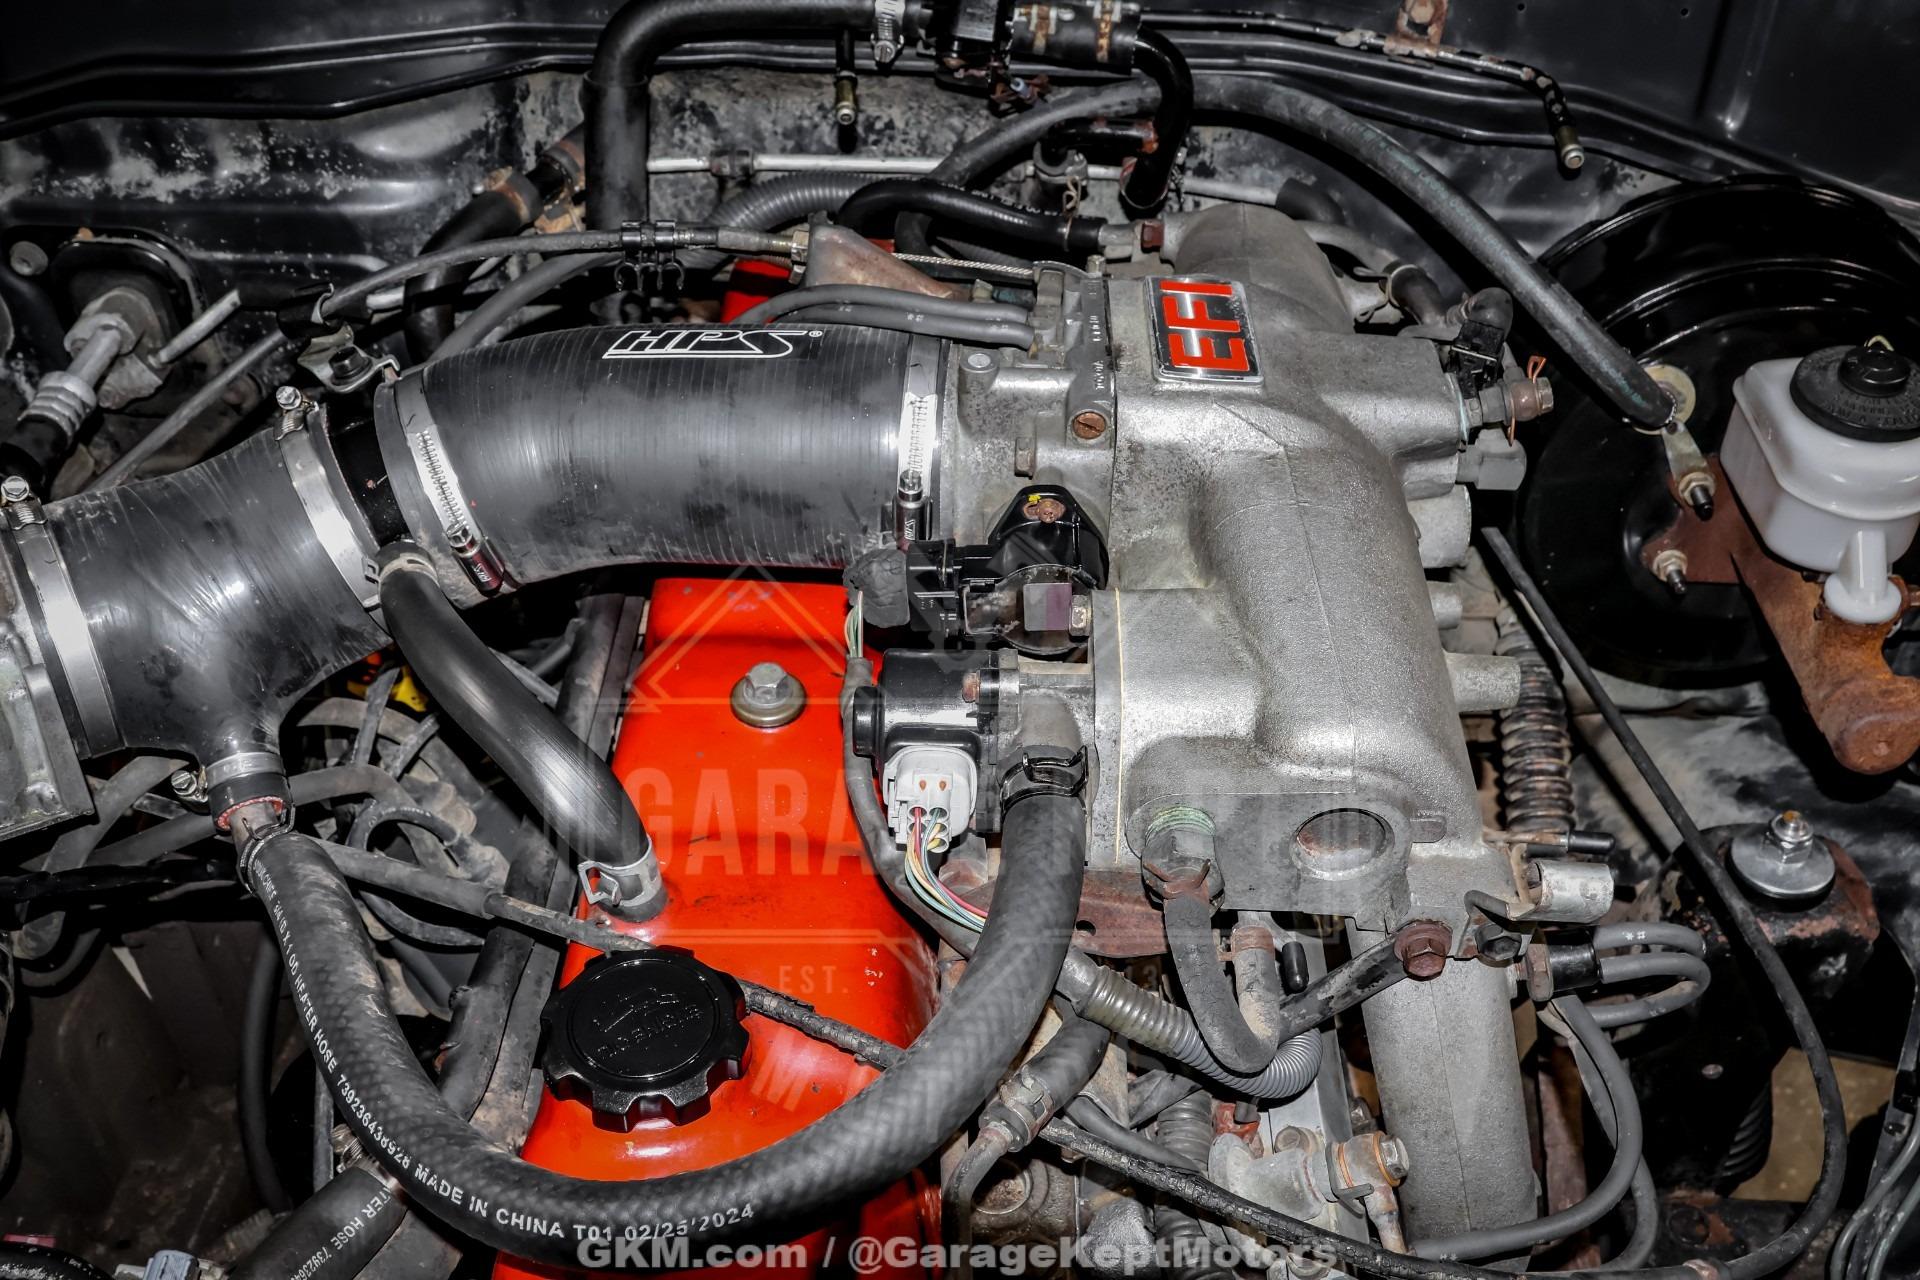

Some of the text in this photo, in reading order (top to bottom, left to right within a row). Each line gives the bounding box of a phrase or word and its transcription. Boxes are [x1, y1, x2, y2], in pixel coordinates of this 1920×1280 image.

[1160, 279, 1250, 371] EFI
[294, 973, 318, 1032] HEATER
[313, 1029, 338, 1074] HOSE
[414, 1162, 464, 1207] MADE
[468, 1195, 489, 1218] IN
[495, 1207, 565, 1240] CHINA
[330, 1216, 365, 1251] HOSE
